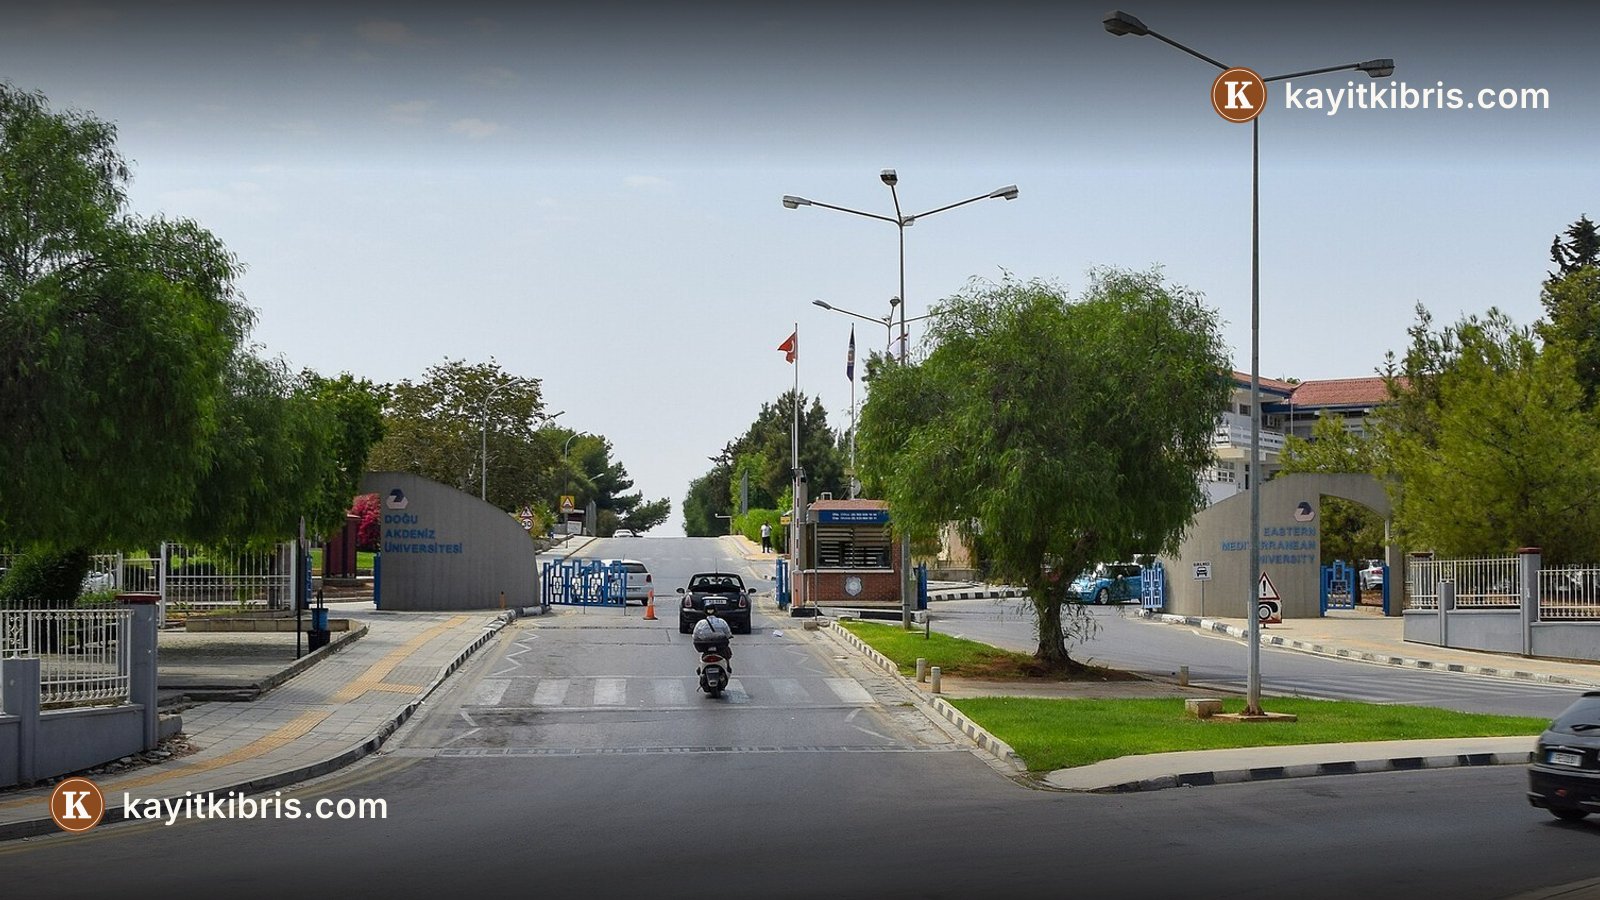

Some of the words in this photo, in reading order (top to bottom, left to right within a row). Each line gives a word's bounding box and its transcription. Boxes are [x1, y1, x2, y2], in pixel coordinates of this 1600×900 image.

[384, 513, 418, 524] DOĞU
[385, 528, 436, 539] AKDENİZ
[1264, 527, 1316, 536] EASTERN
[1222, 541, 1316, 551] MEDIRRANEAN
[1258, 554, 1315, 564] NIVERSITY
